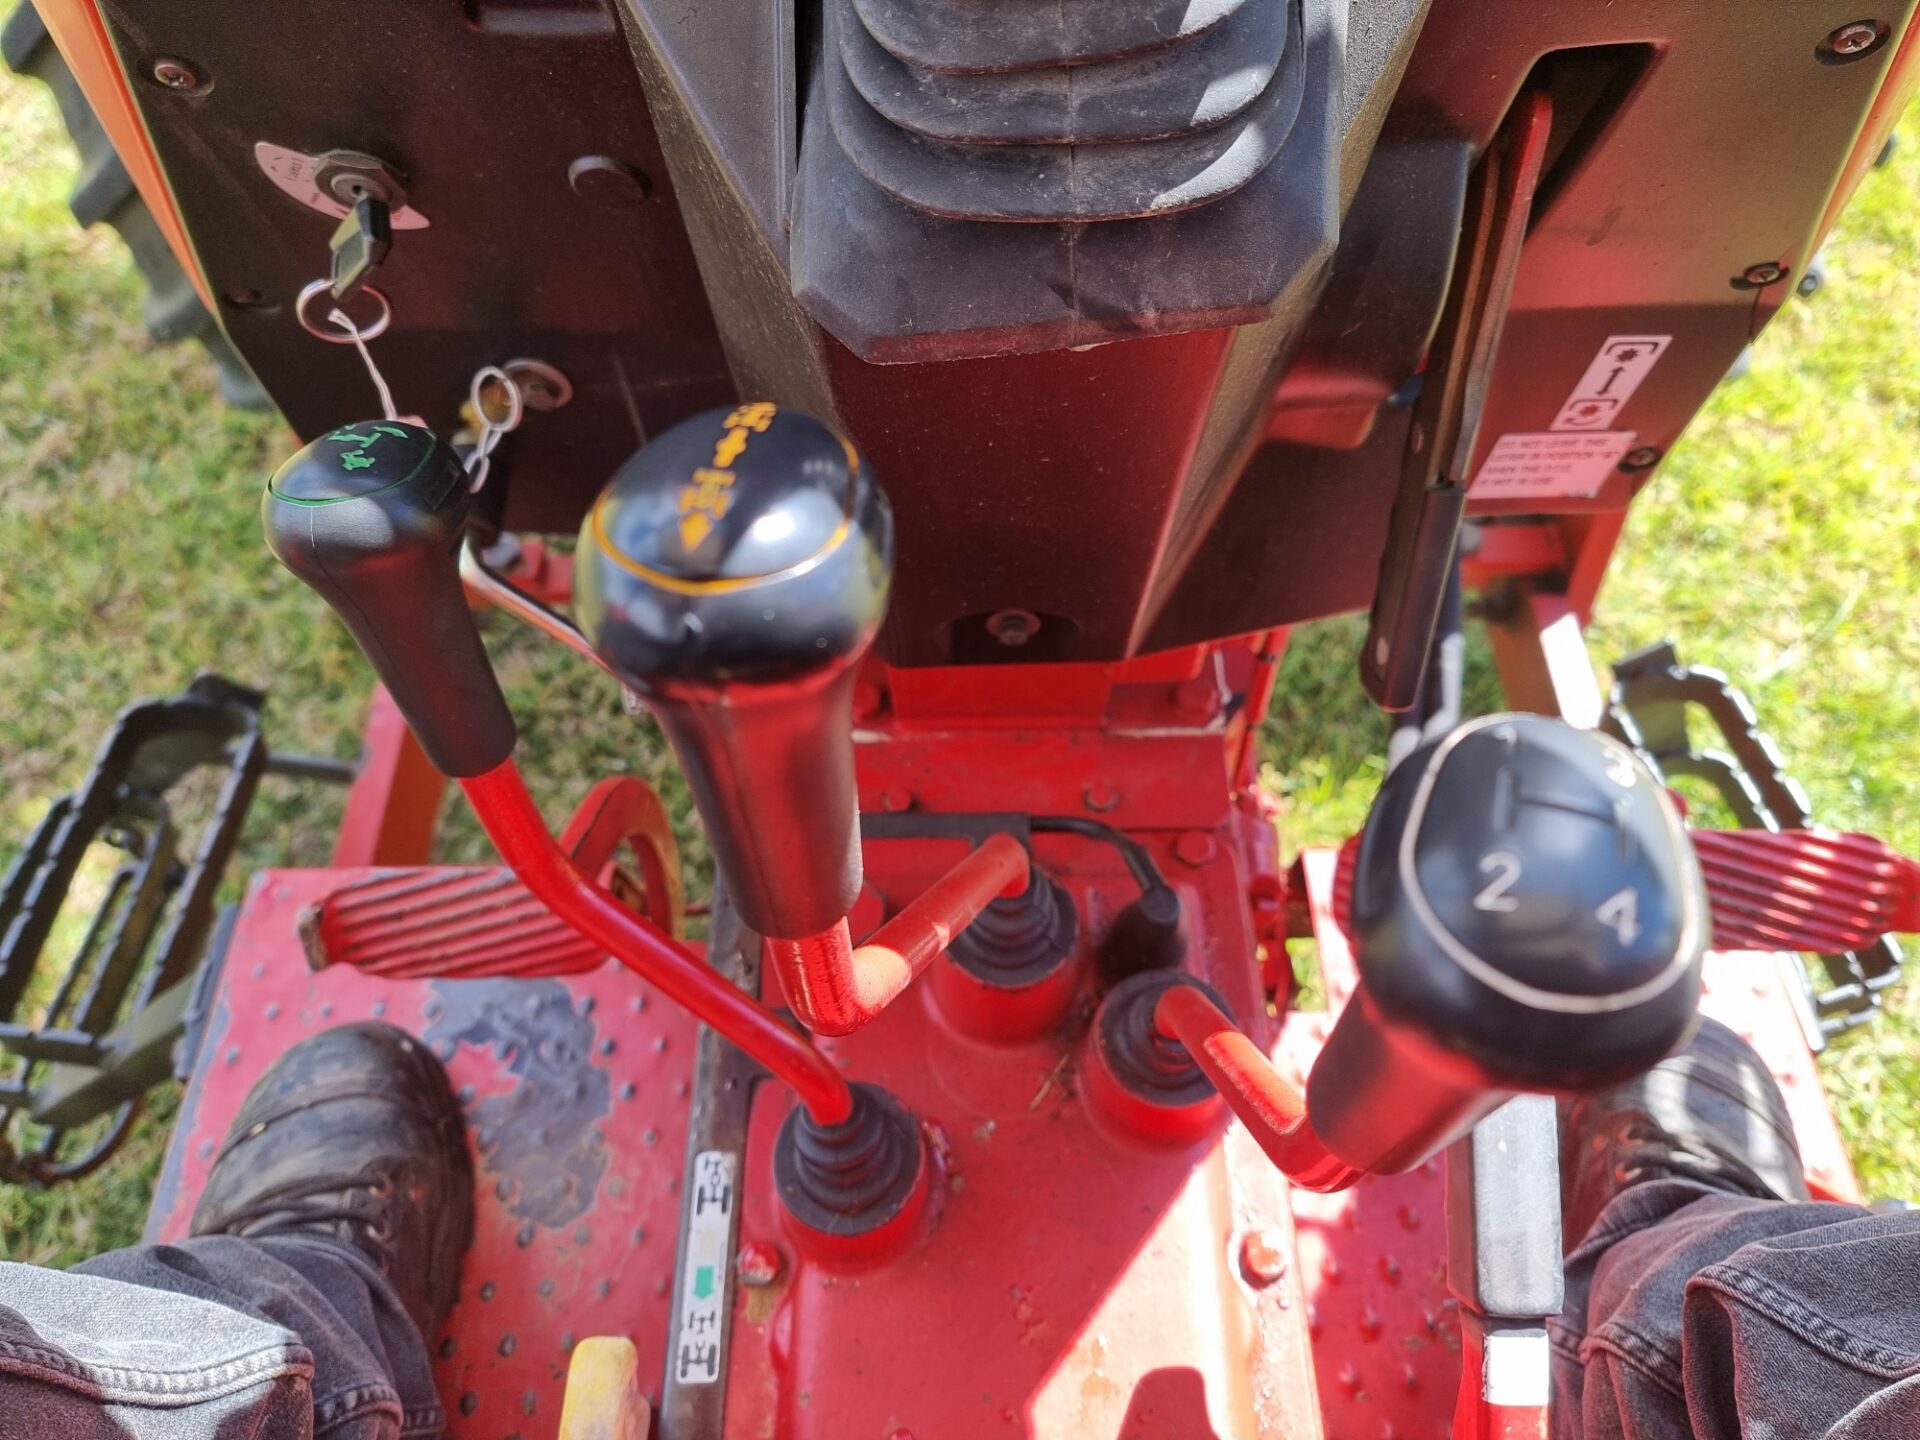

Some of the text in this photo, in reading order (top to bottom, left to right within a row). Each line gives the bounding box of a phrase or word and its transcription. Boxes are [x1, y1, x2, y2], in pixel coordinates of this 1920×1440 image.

[1603, 747, 1637, 788] 3
[1473, 850, 1523, 912] 2
[1596, 886, 1641, 947] 4
